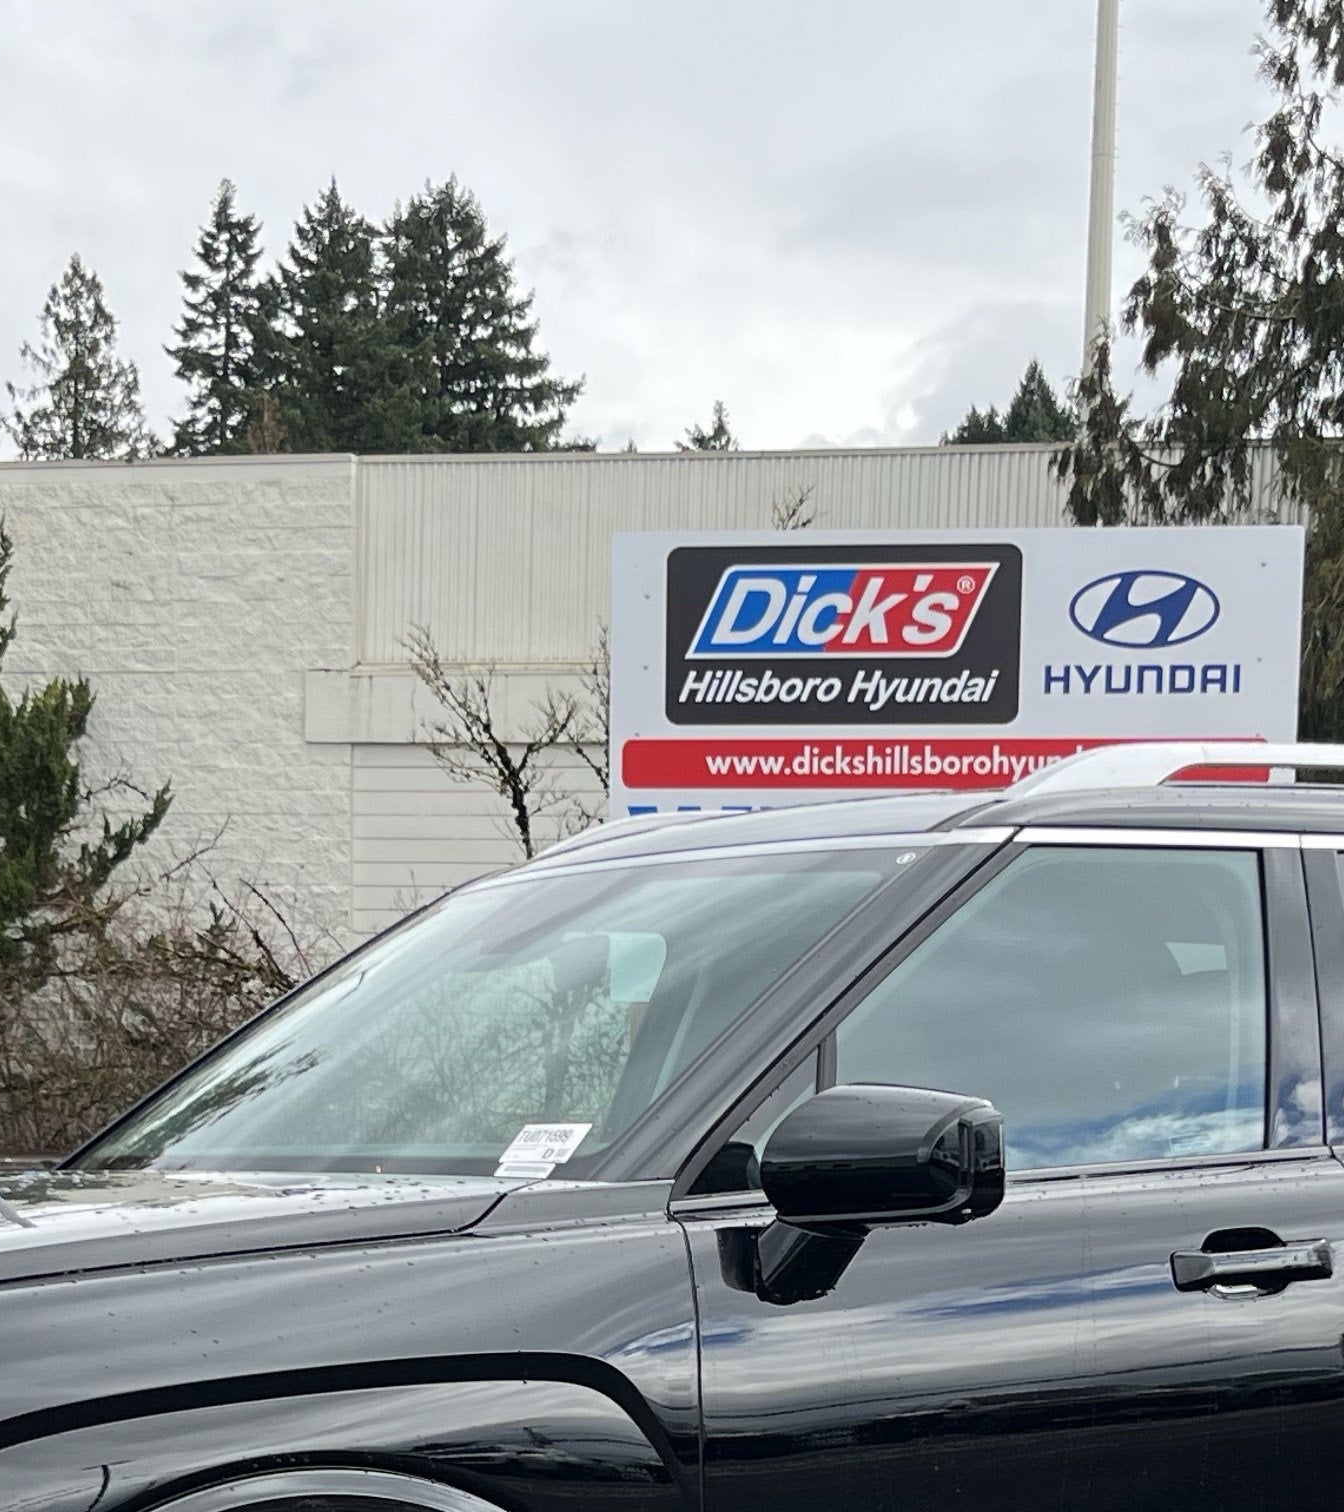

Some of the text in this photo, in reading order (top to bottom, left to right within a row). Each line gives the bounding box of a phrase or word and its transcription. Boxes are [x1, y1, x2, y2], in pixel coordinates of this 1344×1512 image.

[678, 669, 1000, 712] Hillsboro Hyundai
[1043, 663, 1241, 695] HYUNDAI
